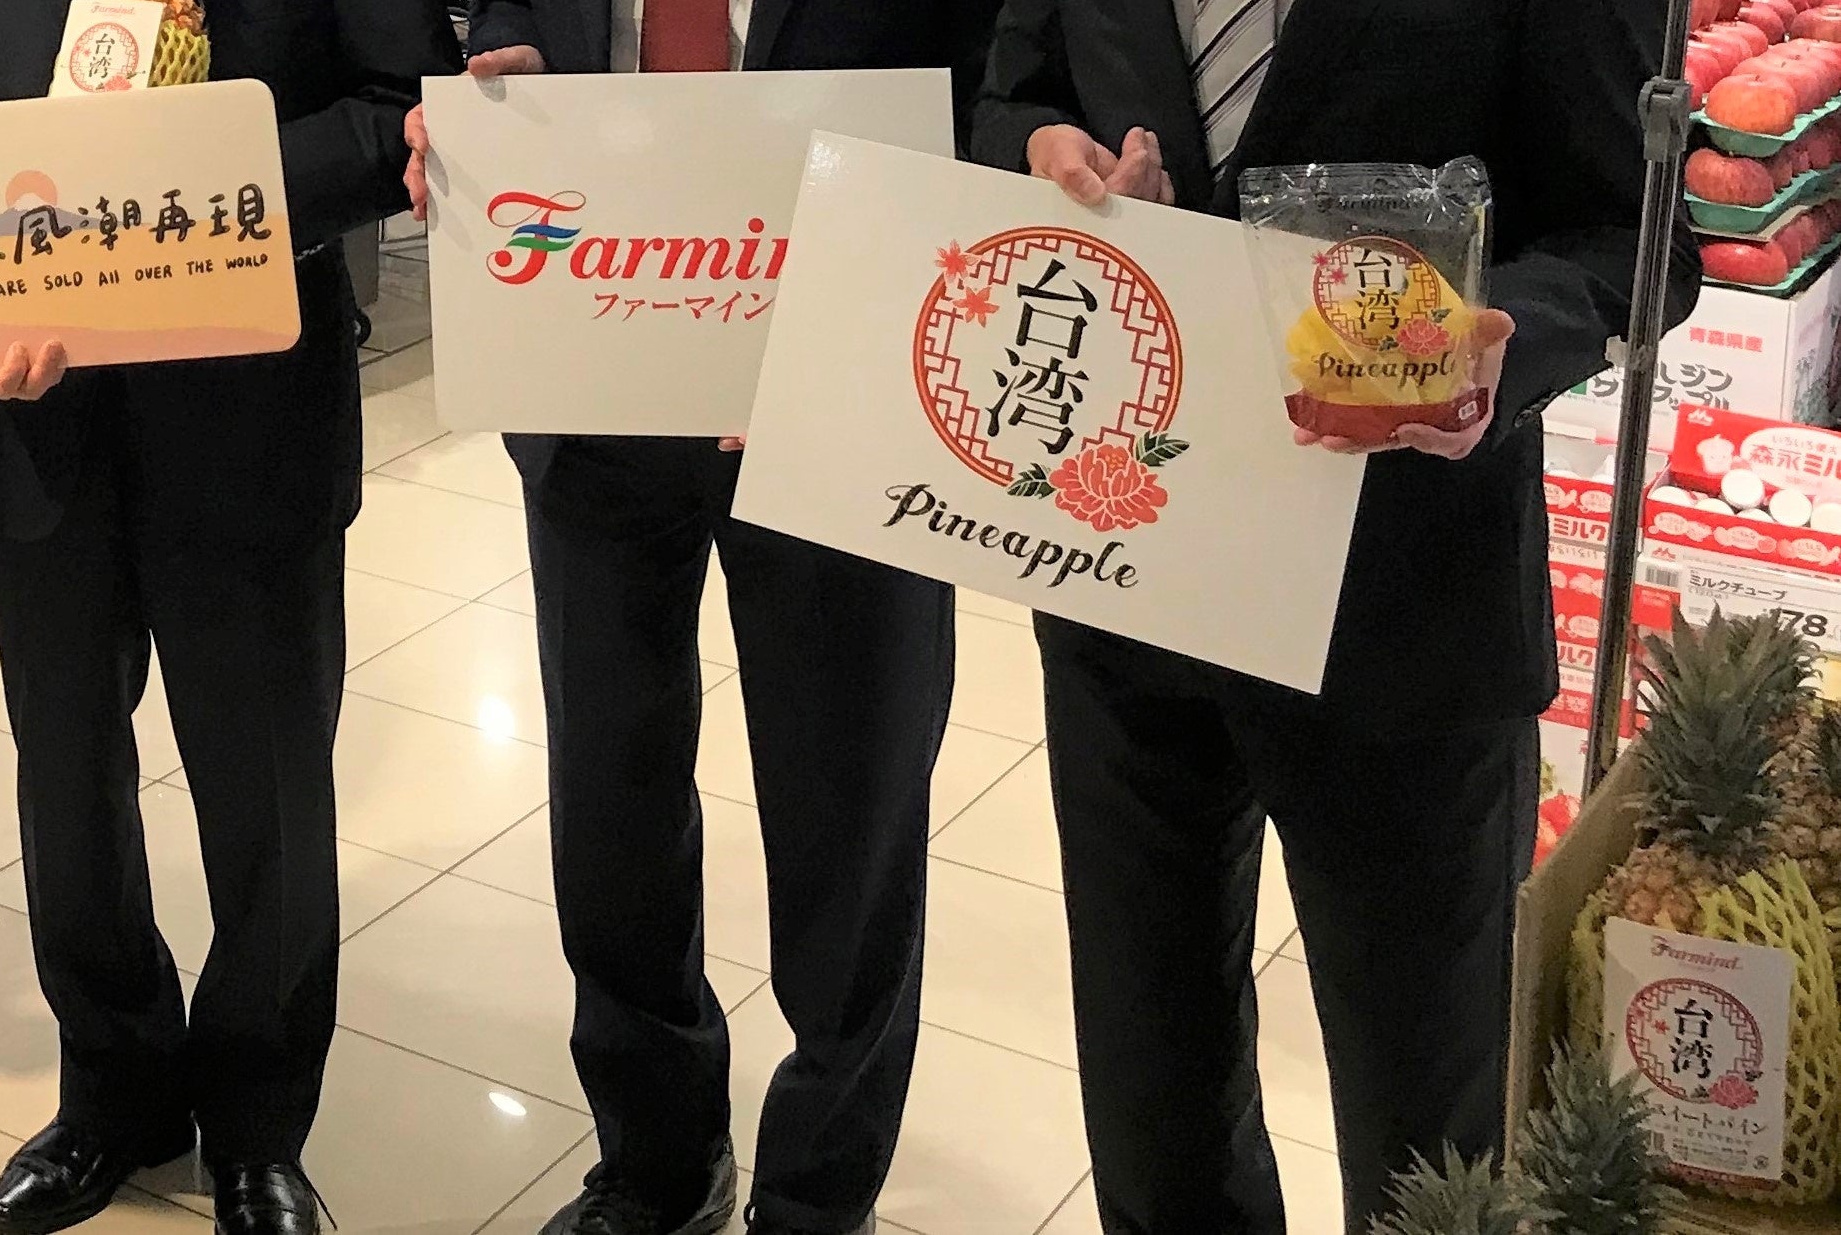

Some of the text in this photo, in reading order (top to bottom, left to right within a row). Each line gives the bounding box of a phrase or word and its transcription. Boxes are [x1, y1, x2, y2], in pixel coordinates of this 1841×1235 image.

[88, 32, 116, 80] 台湾
[43, 269, 84, 291] SOLD
[134, 263, 173, 282] OVER
[186, 257, 214, 277] THE
[225, 252, 270, 271] WORLD
[1353, 247, 1401, 331] 台湾
[987, 259, 1099, 456] 台湾
[1689, 326, 1763, 352] 青森県産
[883, 482, 1139, 590] Pineapple
[1554, 517, 1607, 542] ミルク
[1689, 573, 1787, 601] ミルクチューブ
[1772, 607, 1828, 638] 78
[1668, 997, 1714, 1079] 台湾
